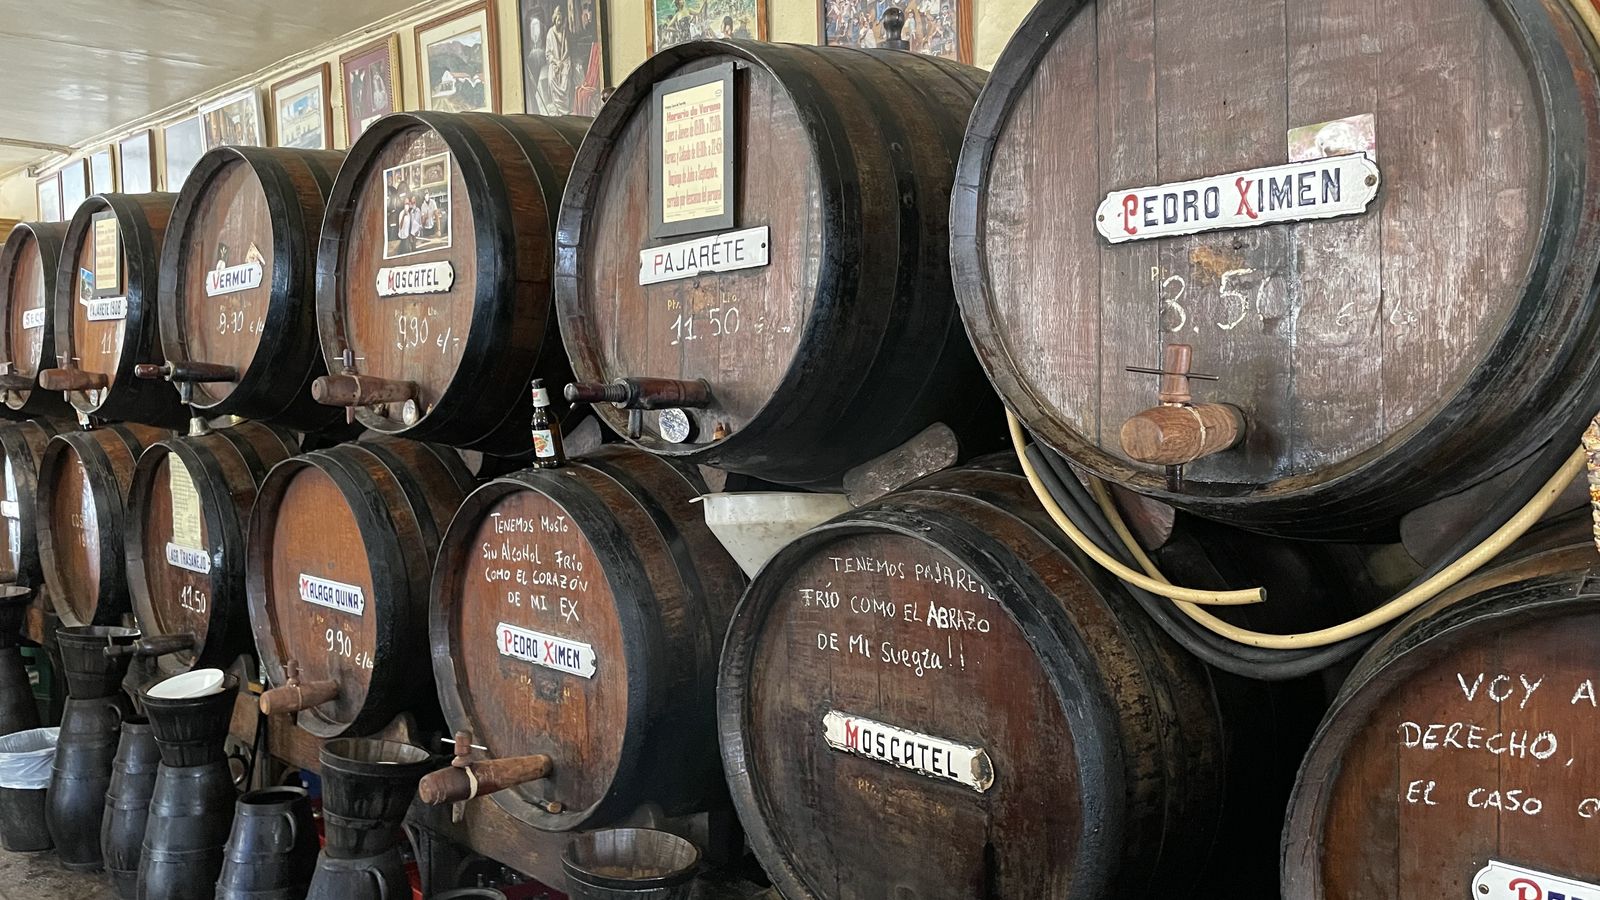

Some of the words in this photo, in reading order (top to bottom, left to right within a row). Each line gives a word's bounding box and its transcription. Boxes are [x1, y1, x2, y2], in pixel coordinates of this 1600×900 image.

[1120, 186, 1220, 235] PEDRO
[1235, 167, 1341, 219] XIMEN
[653, 238, 745, 276] PAJARETE
[213, 268, 253, 289] VERMUT
[388, 268, 439, 291] MOSCATEL
[829, 556, 904, 579] TENEMOS
[302, 577, 334, 604] MALAGA
[335, 589, 359, 609] QUINA
[508, 592, 520, 607] DE
[531, 594, 547, 611] MI
[560, 597, 579, 624] EX
[851, 595, 896, 618] COMO
[904, 603, 922, 622] EL
[927, 601, 990, 632] ABRAZO
[503, 629, 538, 658] PEDRO
[544, 640, 580, 670] XIMEN
[818, 633, 839, 651] DE
[849, 634, 871, 658] MI
[1457, 672, 1545, 711] VOY
[1570, 679, 1598, 707] A
[845, 719, 958, 778] MOSCATEL
[1467, 787, 1542, 815] CASO
